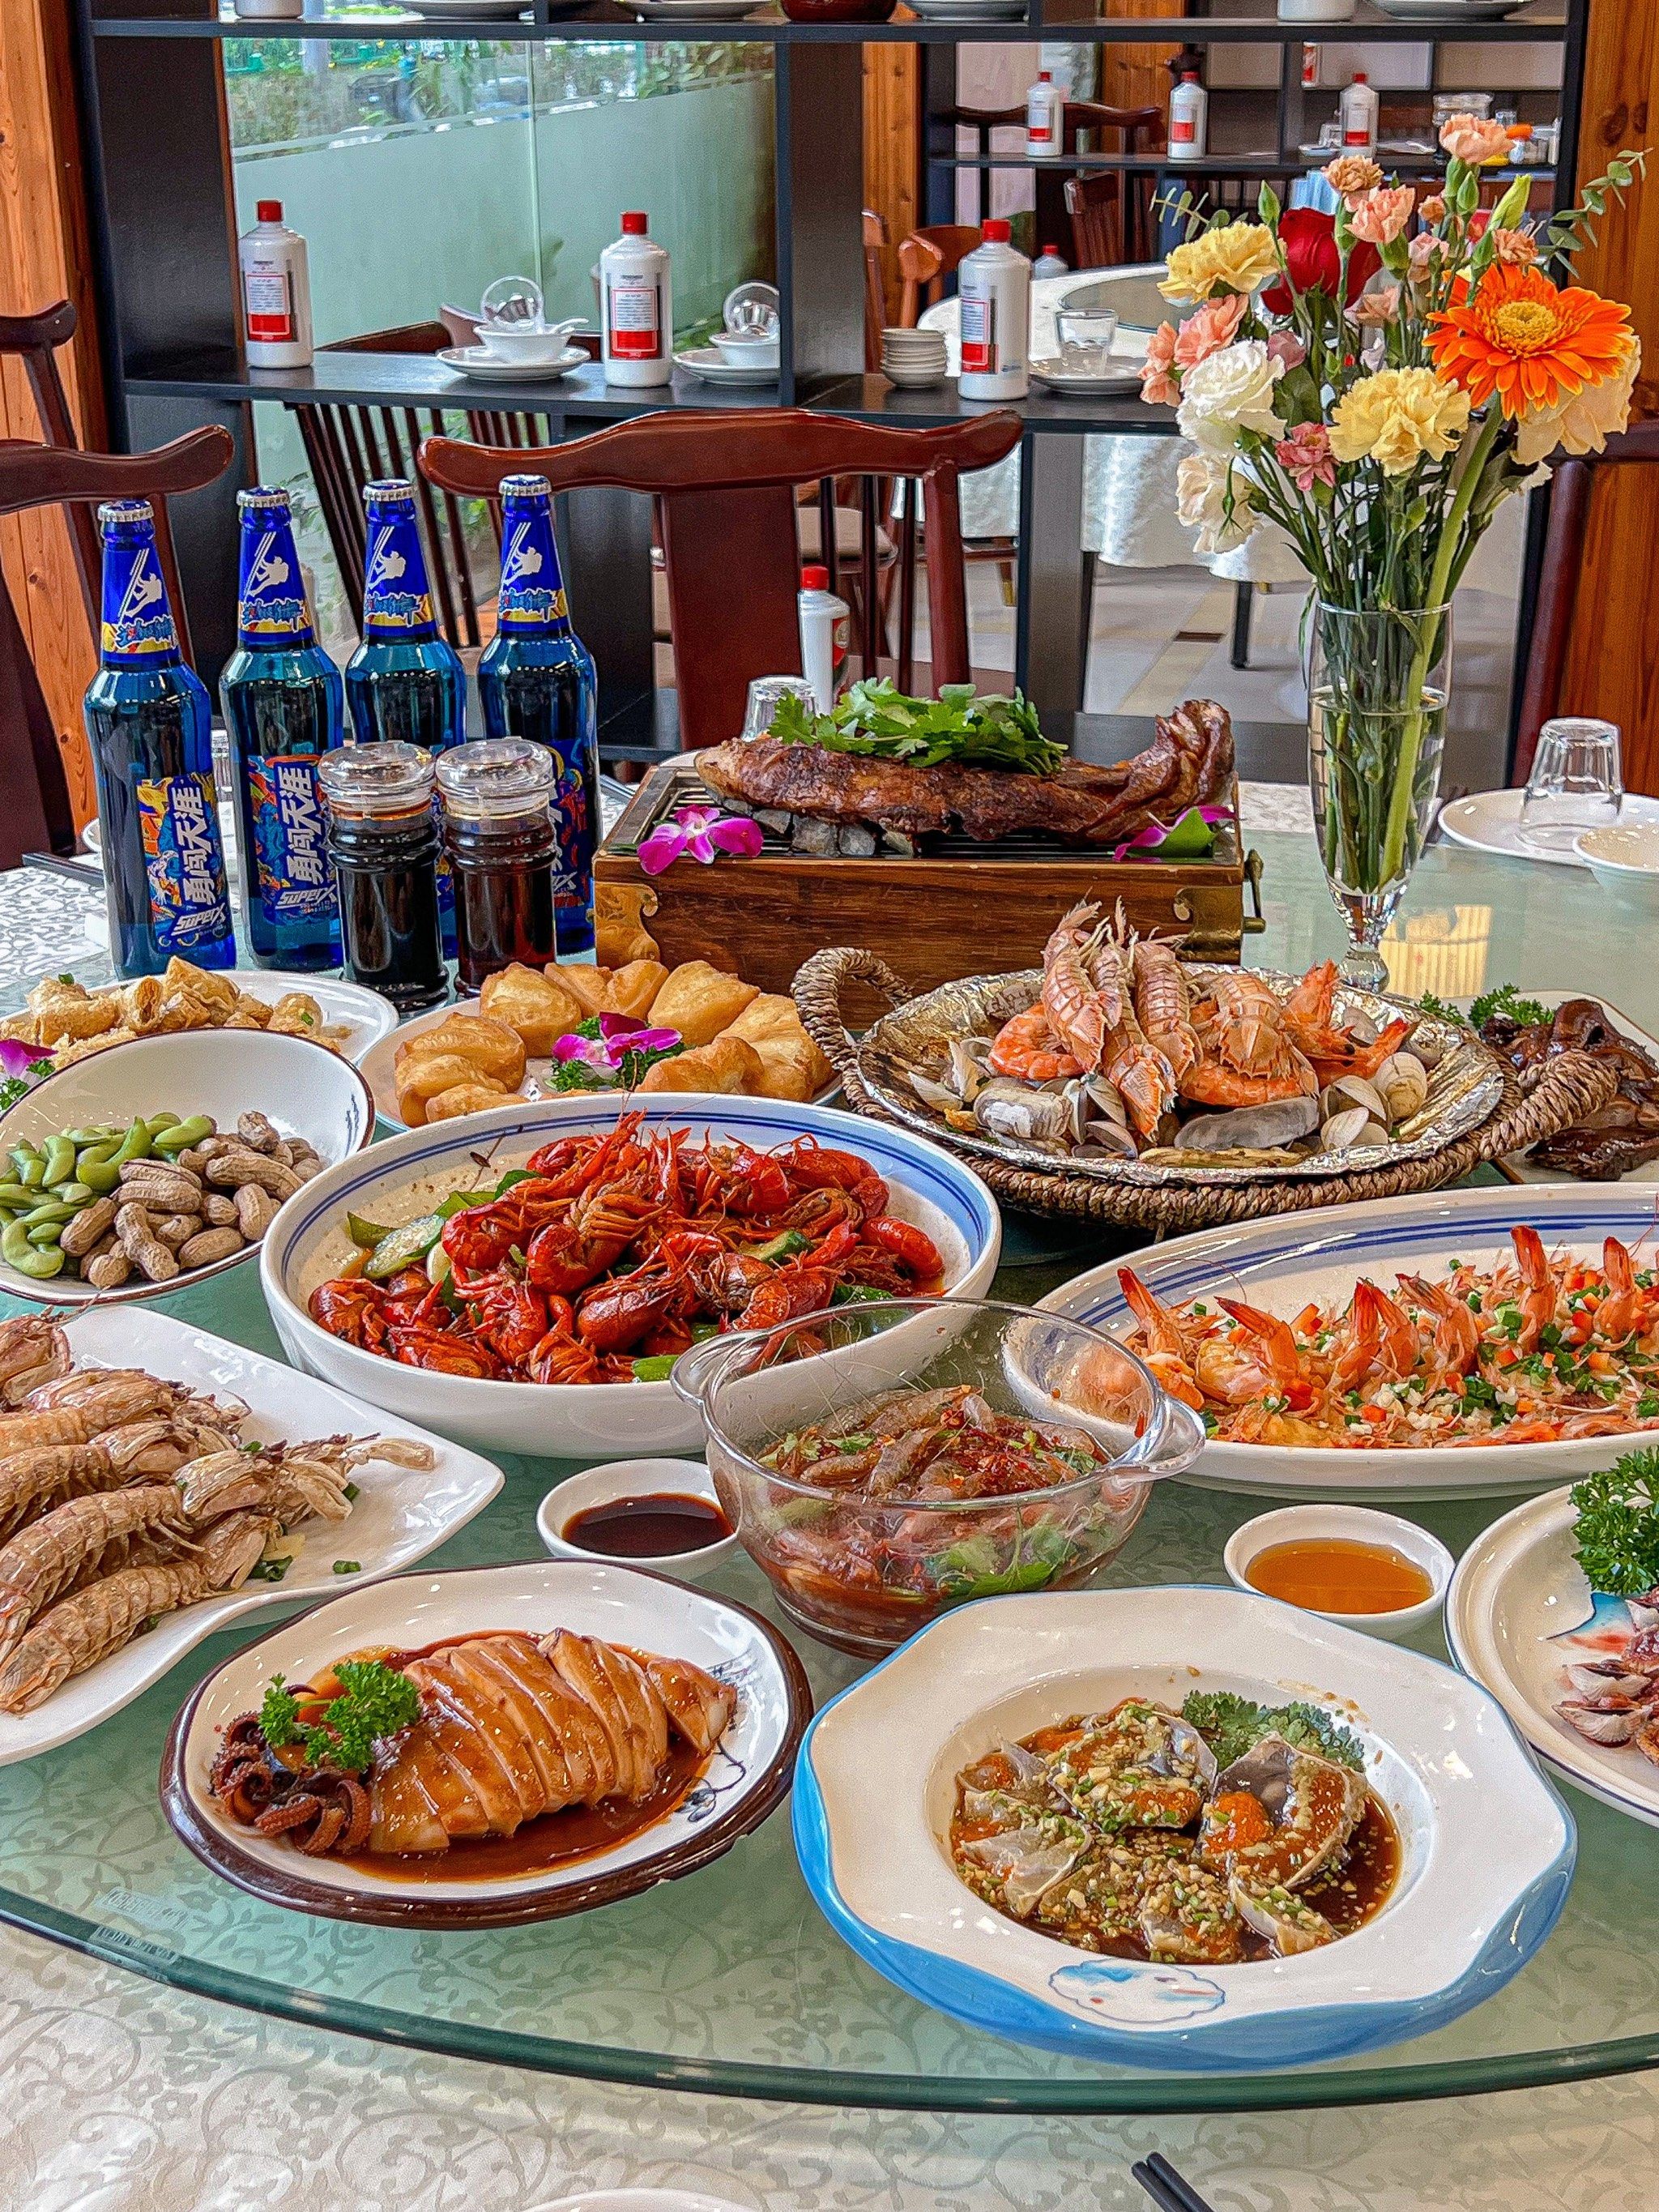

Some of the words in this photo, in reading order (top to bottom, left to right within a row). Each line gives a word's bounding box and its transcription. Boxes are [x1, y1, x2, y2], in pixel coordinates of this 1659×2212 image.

[171, 787, 216, 905] 勇闯天涯
[277, 767, 324, 885] 勇闯天涯
